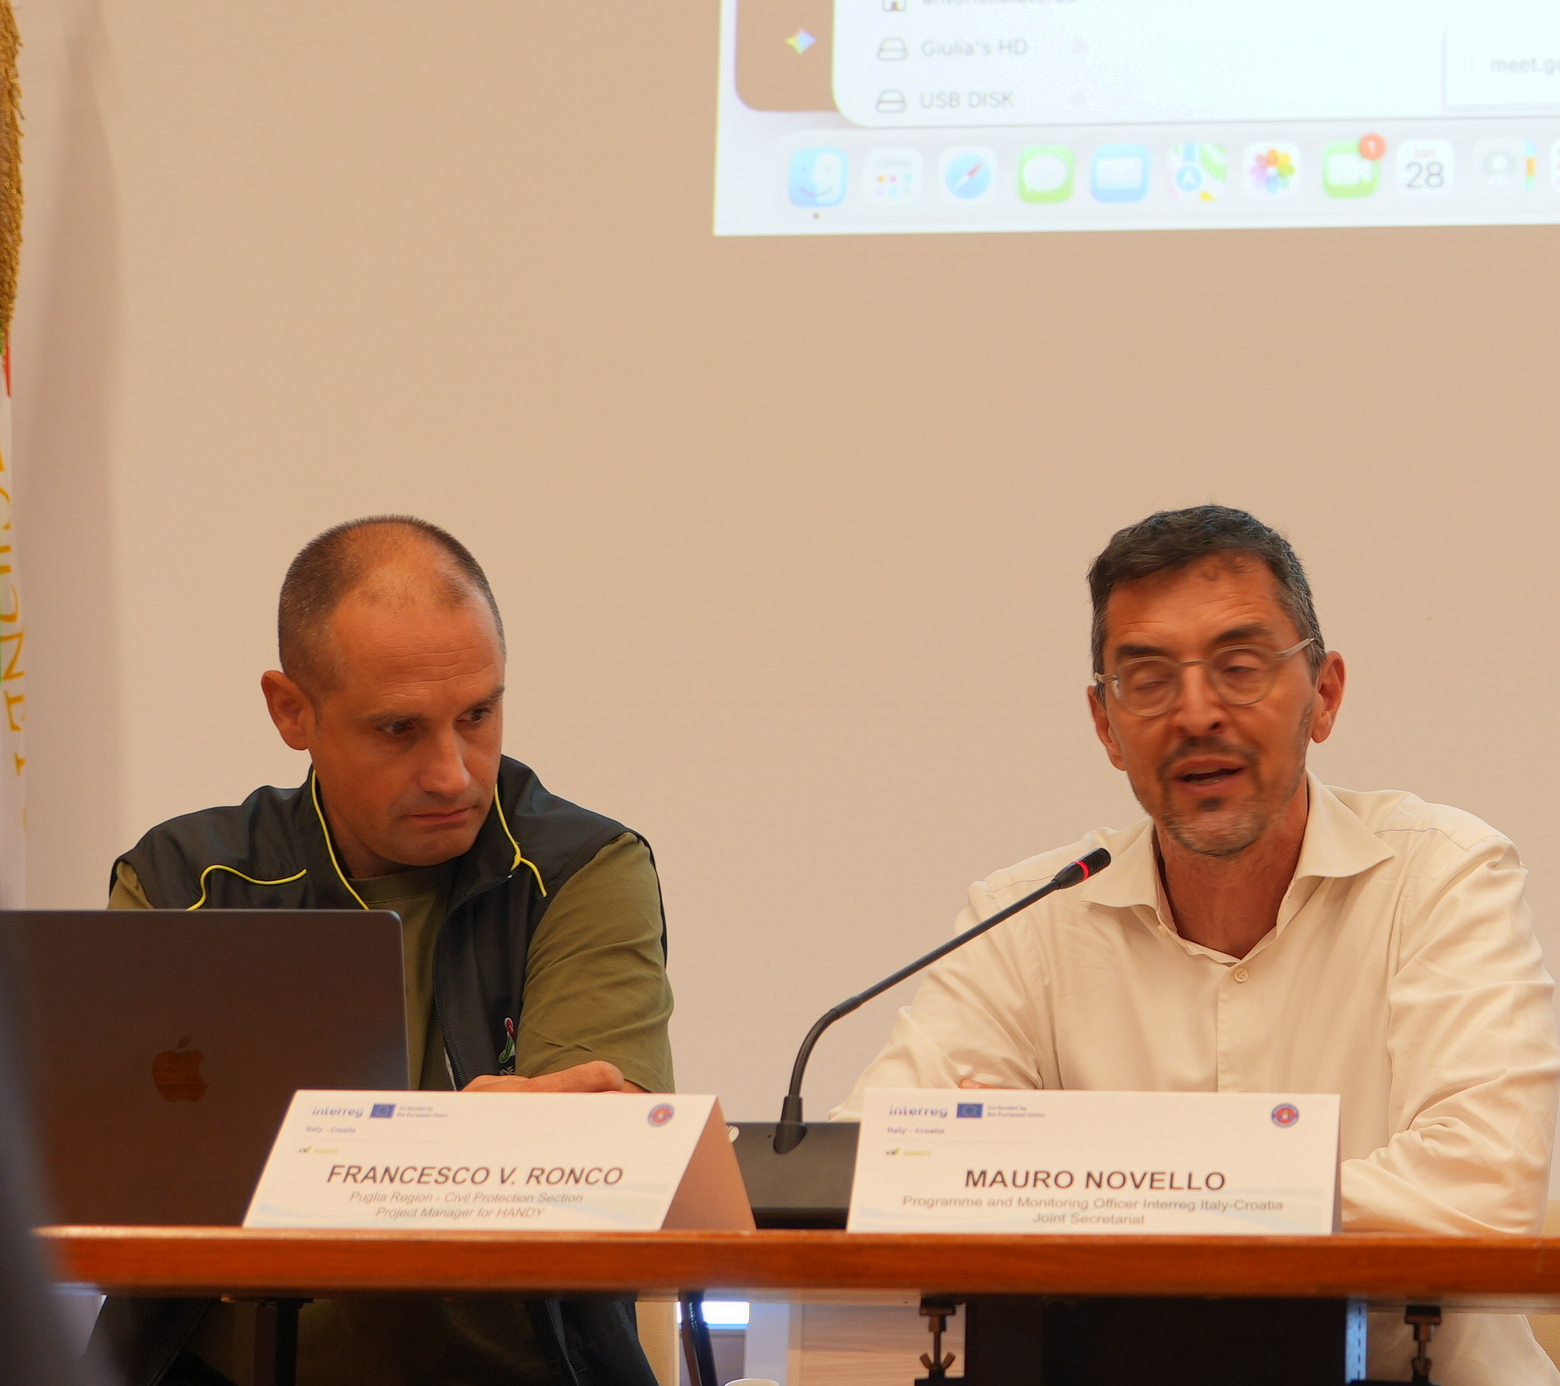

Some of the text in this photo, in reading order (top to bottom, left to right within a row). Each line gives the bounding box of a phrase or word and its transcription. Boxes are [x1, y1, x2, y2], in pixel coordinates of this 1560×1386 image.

[921, 37, 1029, 59] Giulia's HD
[919, 89, 1014, 111] USB DISK
[1403, 159, 1445, 191] 28
[326, 1165, 623, 1186] FRANCESCO V. RONCO
[964, 1169, 1226, 1192] MAURO NOVELLO
[350, 1191, 583, 1205] Puglia Region Civil Protection Section
[902, 1196, 1283, 1214] Programme and Monitoring Officer Interreg Italy-Croatia
[376, 1206, 545, 1220] Project Manager for HANDY
[1033, 1212, 1146, 1226] Joint Secretariat
